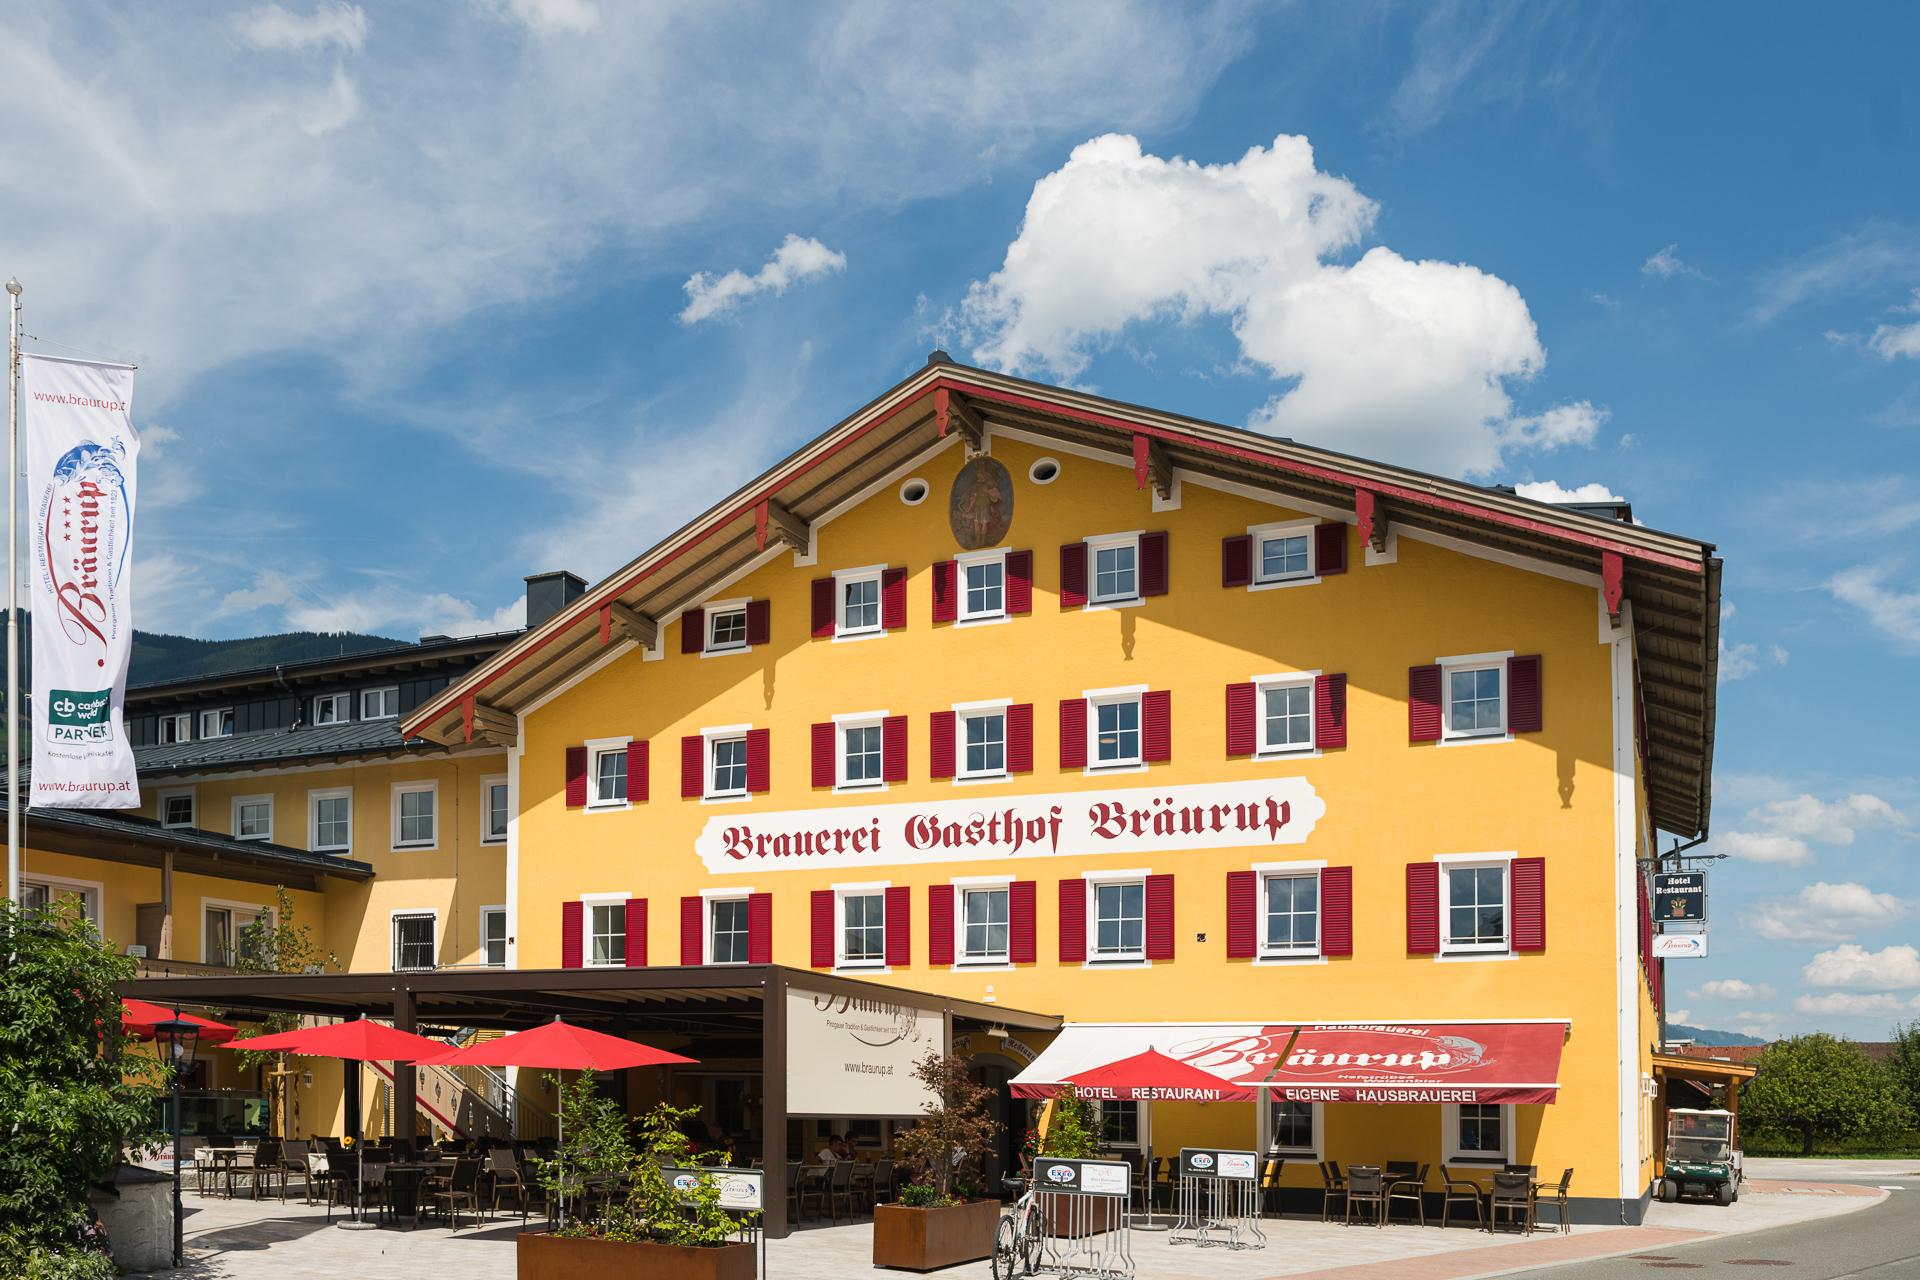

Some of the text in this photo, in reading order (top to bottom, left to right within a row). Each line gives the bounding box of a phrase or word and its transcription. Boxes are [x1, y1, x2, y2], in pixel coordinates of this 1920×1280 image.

[33, 391, 126, 412] www.braurup.t
[38, 522, 46, 567] RESTAURANT
[58, 481, 108, 667] Bräurup
[53, 697, 76, 713] cb
[39, 780, 131, 794] www.braurup.at
[722, 795, 1291, 861] Brauerei Gasthof Bräurup
[1667, 876, 1691, 885] Hotel
[1655, 885, 1703, 894] Restaurant
[844, 1061, 894, 1078] www.braurup.at
[1074, 1086, 1220, 1100] HOTEL RESTAURANT
[1285, 1088, 1477, 1102] EIGENE HAUSBRAUEREI
